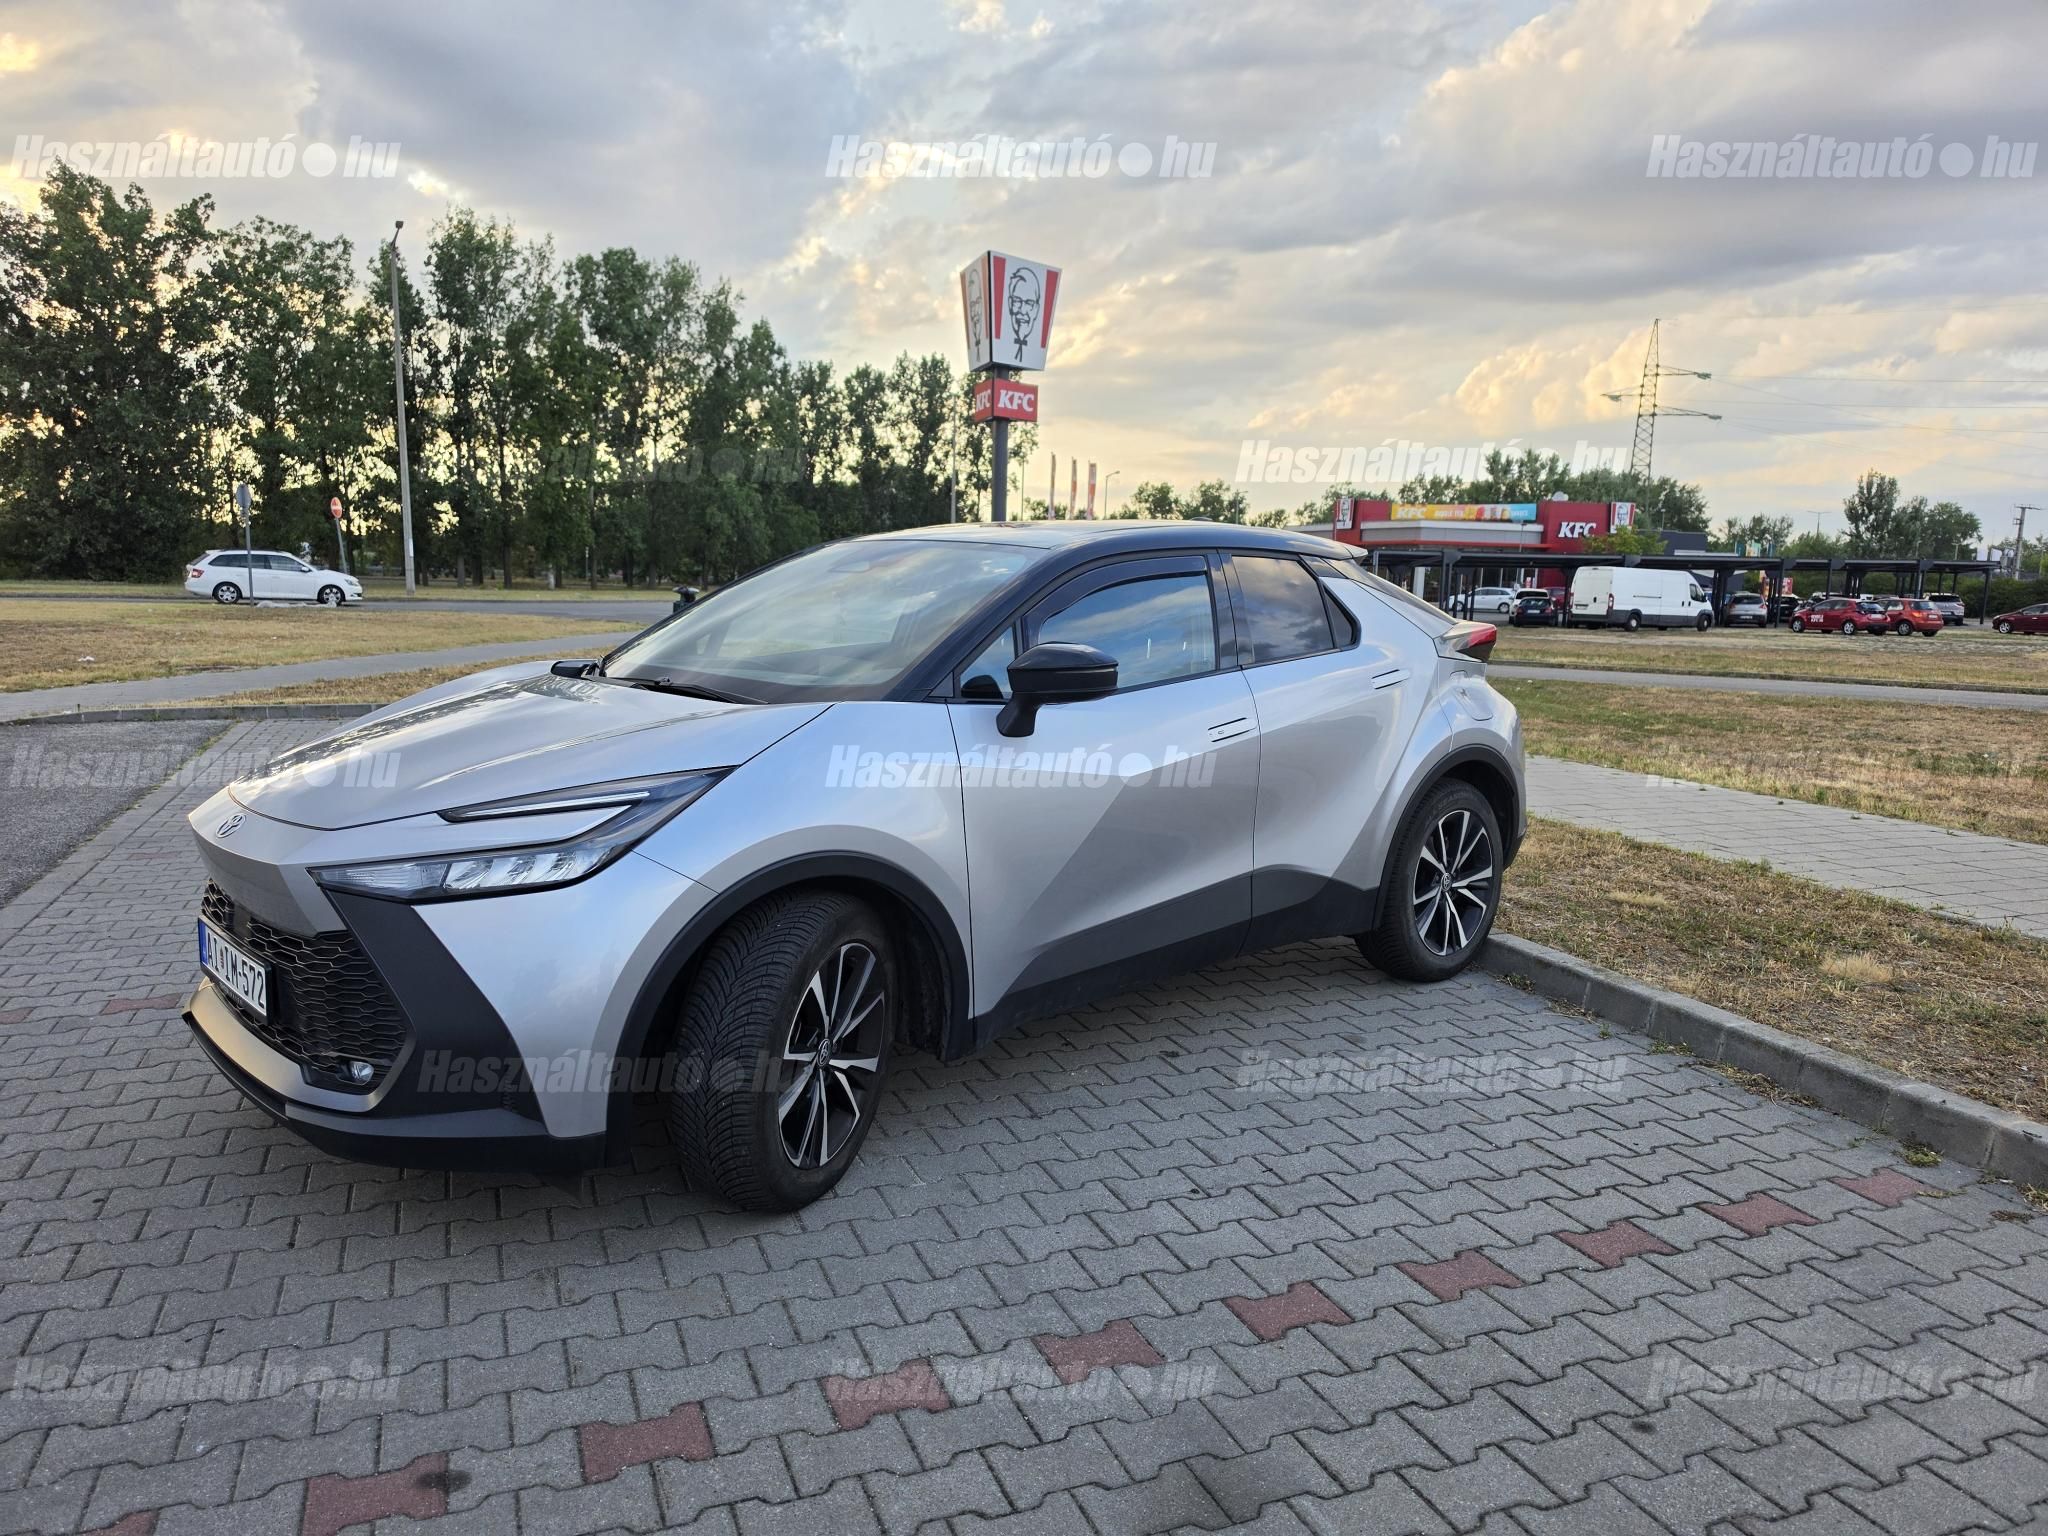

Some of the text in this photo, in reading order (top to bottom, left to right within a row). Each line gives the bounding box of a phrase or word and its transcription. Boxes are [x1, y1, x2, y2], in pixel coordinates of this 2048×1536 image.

[975, 388, 992, 412] KFC
[998, 389, 1035, 412] KFC
[1396, 507, 1427, 519] KFC
[1558, 521, 1597, 538] KFC
[224, 945, 265, 1009] IM-572
